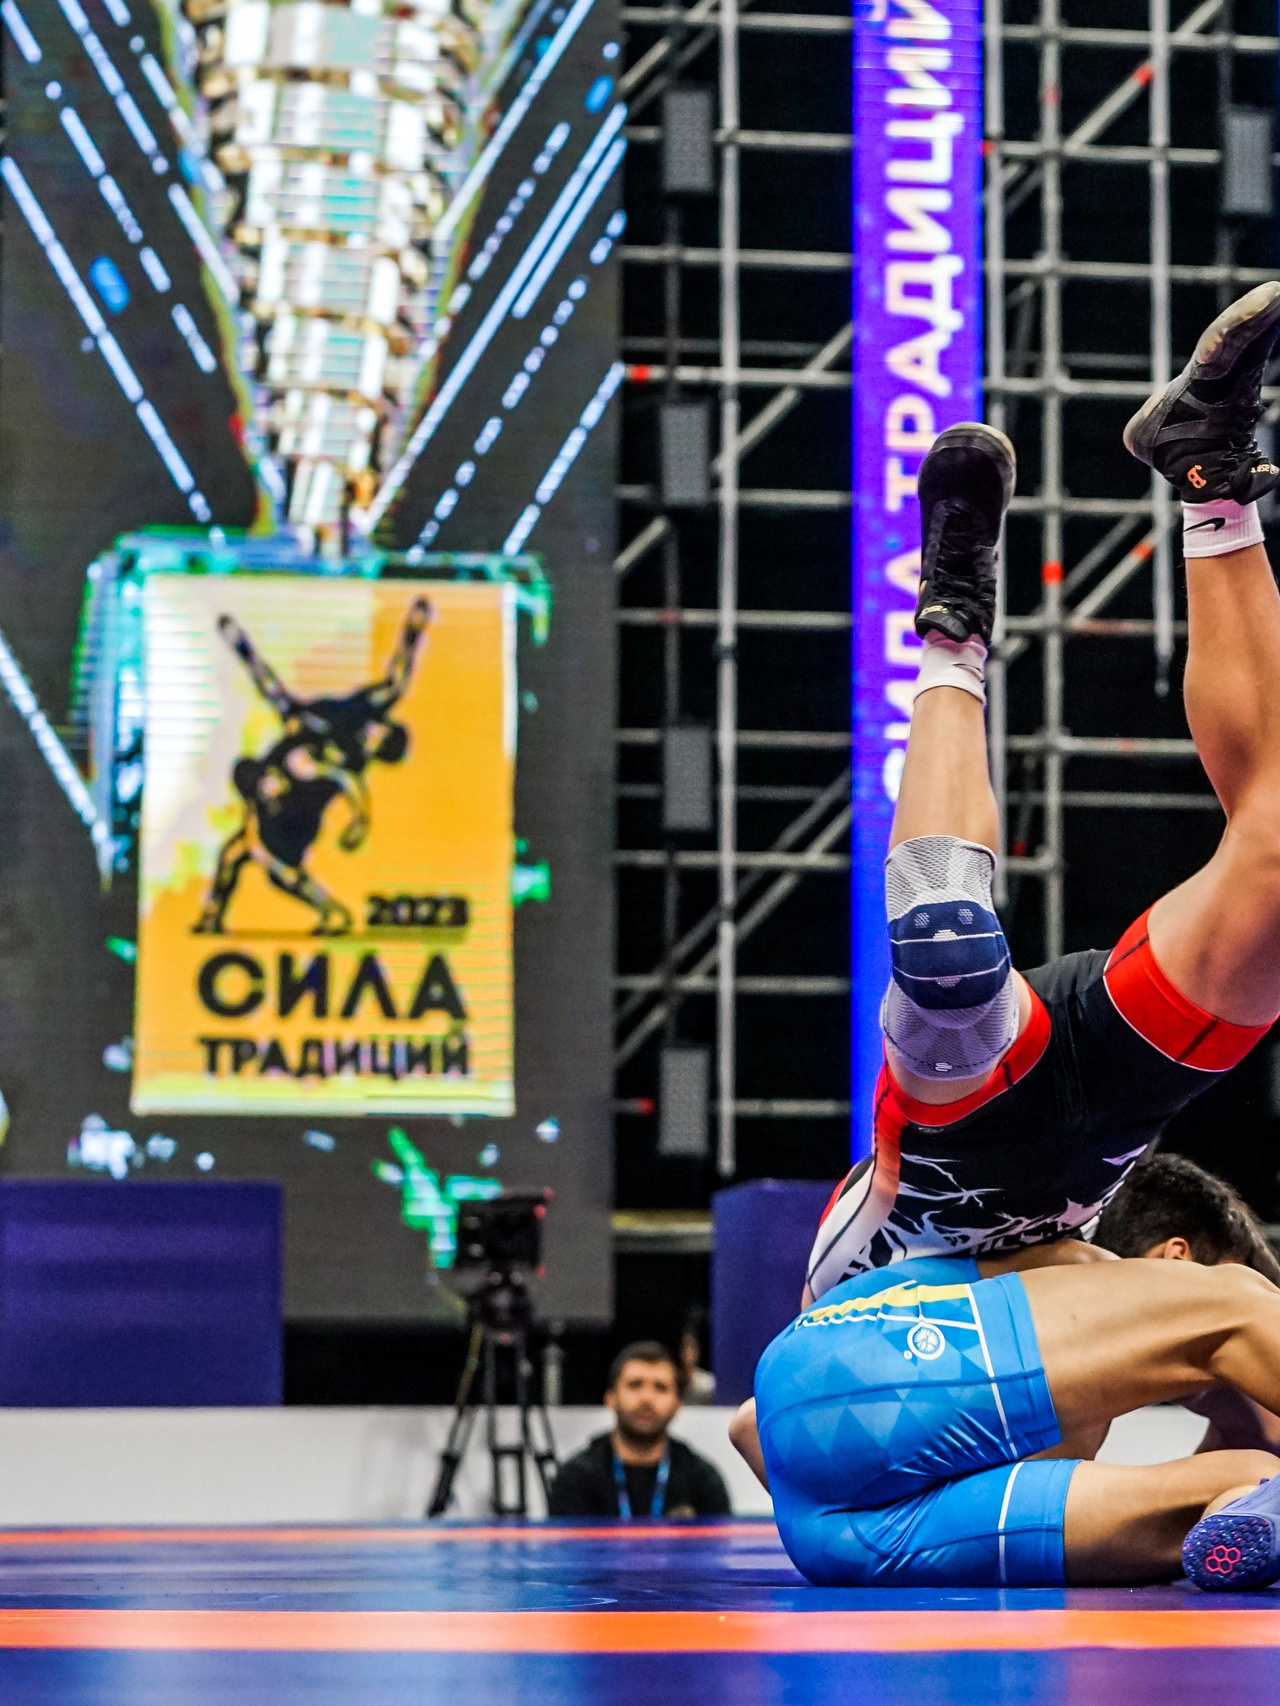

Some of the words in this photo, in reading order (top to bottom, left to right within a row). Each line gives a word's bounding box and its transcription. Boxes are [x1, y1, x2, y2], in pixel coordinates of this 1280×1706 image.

[870, 0, 965, 512] ТРАДИЦИЙ
[367, 895, 468, 927] 2023
[198, 952, 466, 1019] СИЛА
[198, 1028, 469, 1079] ТРАДИЦИЙ
